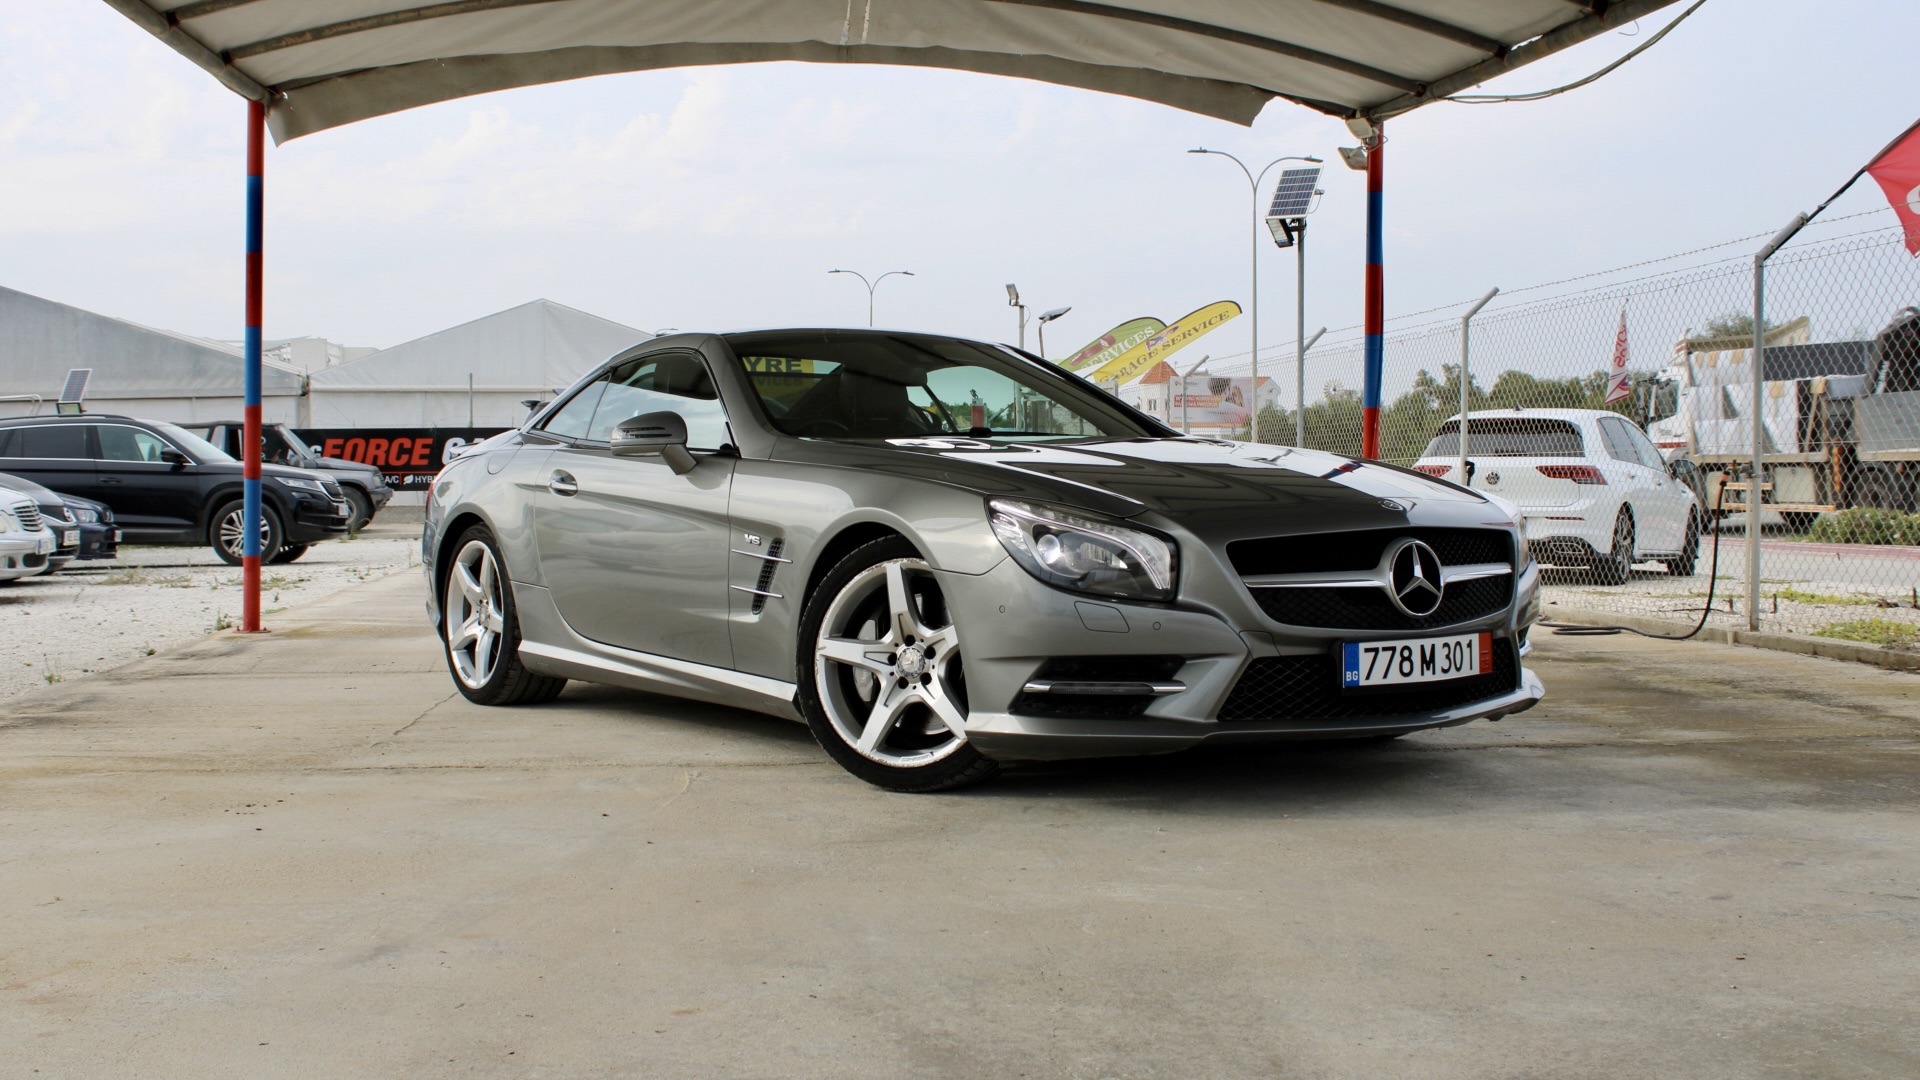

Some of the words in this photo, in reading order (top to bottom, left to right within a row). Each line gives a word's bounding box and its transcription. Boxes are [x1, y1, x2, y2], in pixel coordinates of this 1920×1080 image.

[1099, 350, 1159, 382] GRAGE
[1162, 310, 1230, 352] SERVICE
[323, 437, 433, 466] FORCE
[414, 475, 436, 484] HYB
[1345, 671, 1359, 682] BG
